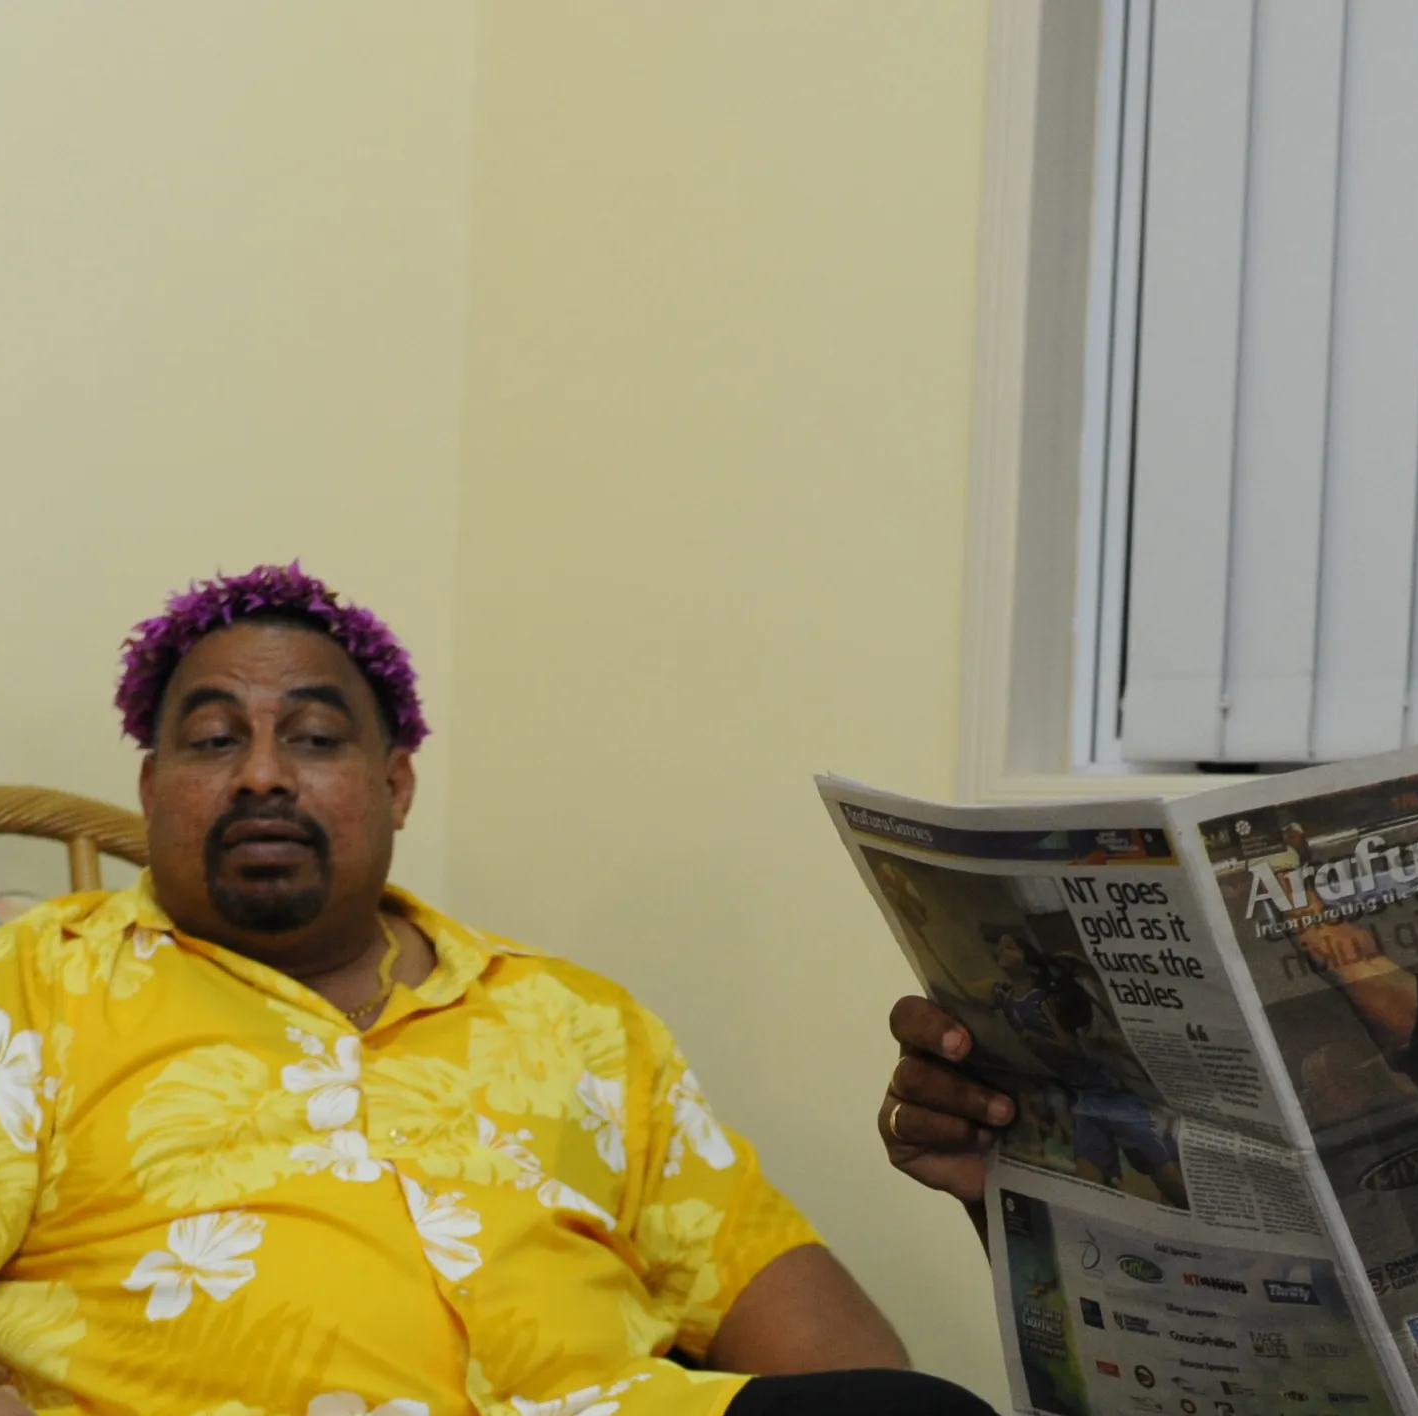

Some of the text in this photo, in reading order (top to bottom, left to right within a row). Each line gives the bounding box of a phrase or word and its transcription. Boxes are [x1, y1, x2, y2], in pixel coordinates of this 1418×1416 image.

[845, 803, 934, 844] Arafura Games
[1061, 876, 1169, 911] NT goes
[1080, 905, 1192, 945] gold as it
[1255, 892, 1378, 938] Incorporating
[1091, 948, 1205, 981] turns the
[1109, 978, 1185, 1012] tables
[1268, 1284, 1311, 1302] Thrifty
[1169, 1330, 1238, 1350] ConocoPhillips
